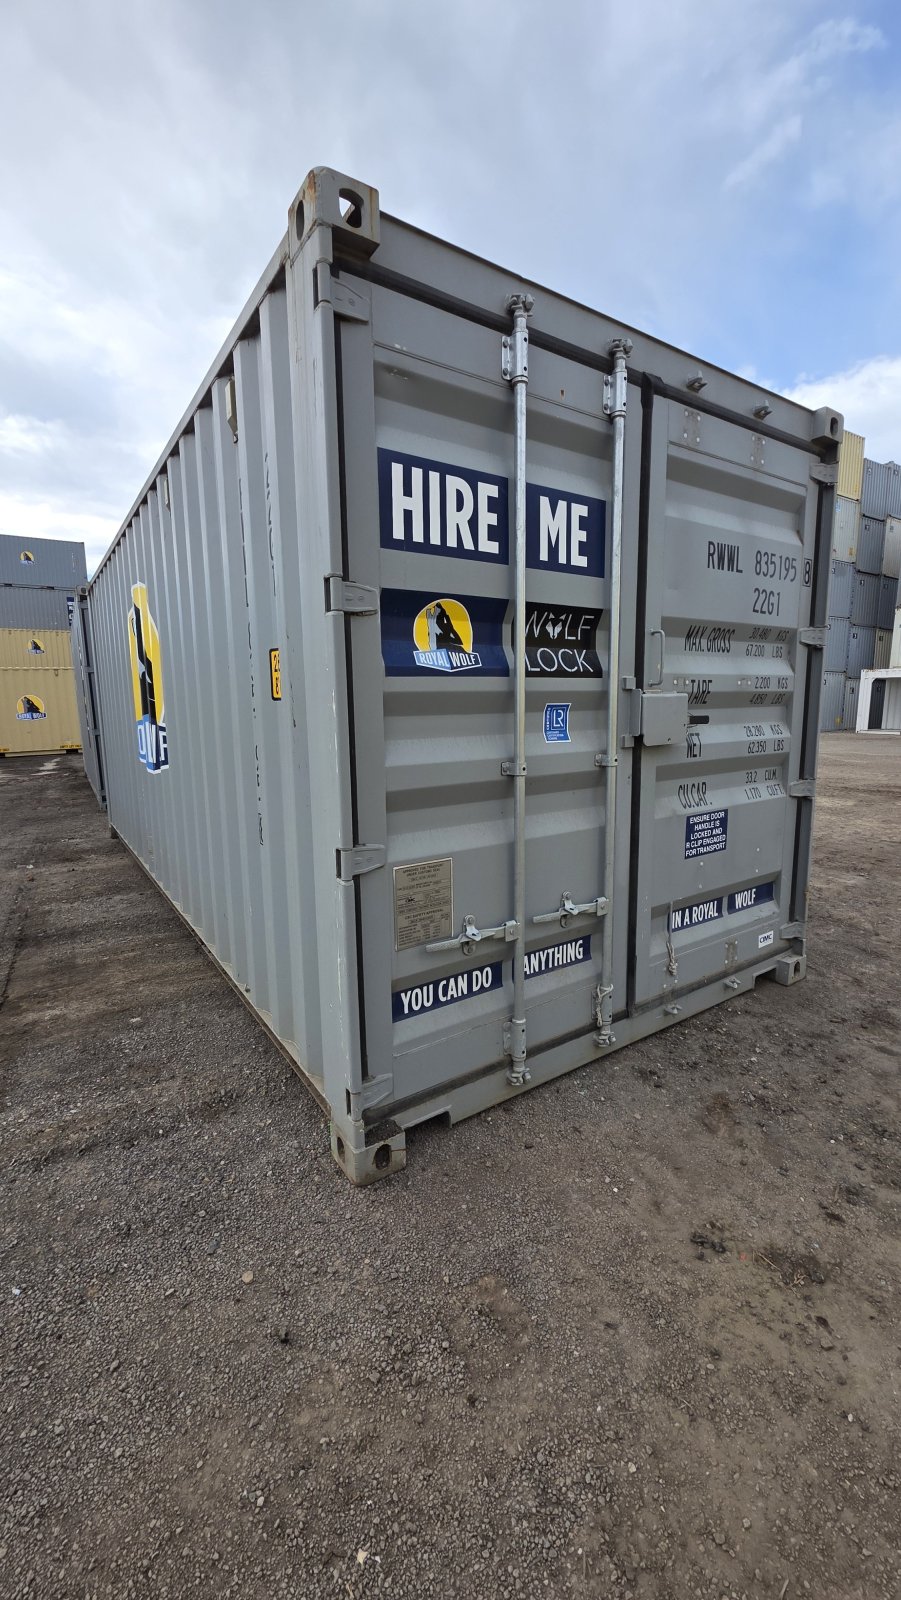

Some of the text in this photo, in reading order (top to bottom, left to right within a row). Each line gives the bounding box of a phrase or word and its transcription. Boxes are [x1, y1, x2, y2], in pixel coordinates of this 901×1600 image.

[391, 461, 589, 568] HIRE ME
[707, 540, 812, 586] RWWL 835195 8
[752, 587, 781, 617] 22G1
[706, 627, 736, 653] GROSS
[775, 629, 790, 642] KGS
[418, 650, 476, 668] ROYAL WOLF
[525, 647, 594, 673] LOCK
[771, 645, 783, 659] LBS
[688, 679, 713, 705] TARE
[777, 677, 789, 690] KGS
[770, 693, 786, 705] LBS
[553, 709, 564, 727] LR
[686, 732, 702, 759] NET
[769, 724, 783, 735] KGS
[773, 739, 785, 752] LBS
[745, 770, 758, 784] 33.2
[690, 811, 725, 824] ENSURE DOOR
[694, 821, 715, 831] HANDLE
[686, 834, 726, 849] R CLIP ENGAGED
[690, 827, 723, 840] LOCKED AND
[686, 842, 726, 857] FOR TRANSPORT
[671, 888, 757, 929] IN A ROYAL WOLF
[759, 933, 773, 944] CIMC
[400, 939, 584, 1015] YOU CAN DO ANYTHING
